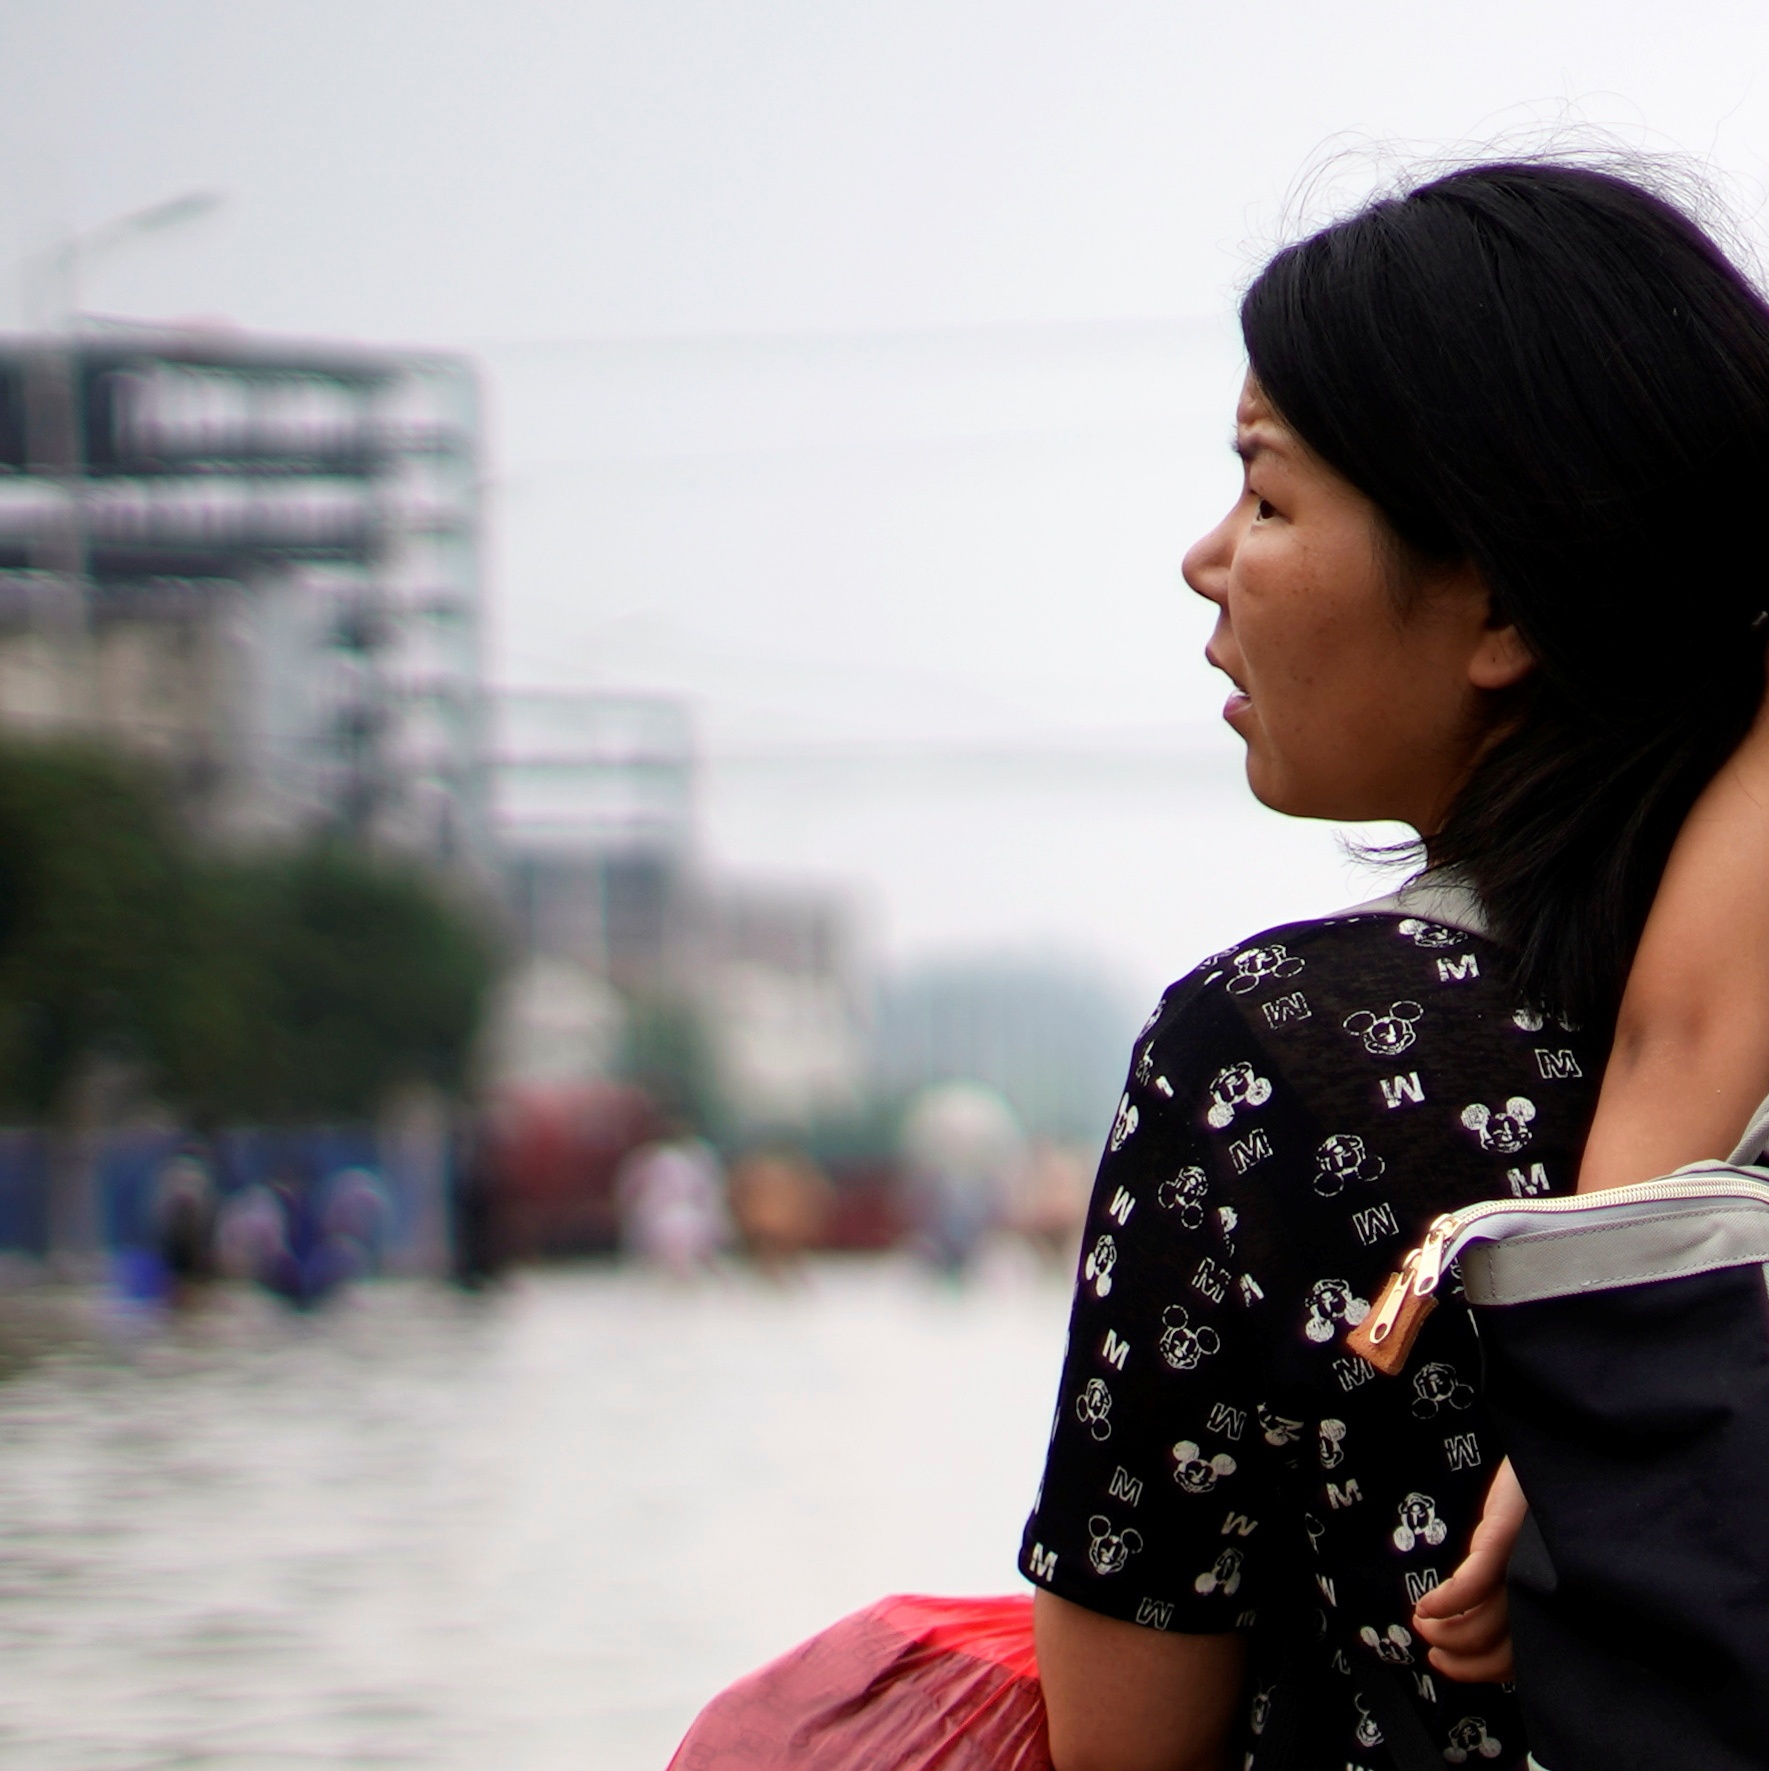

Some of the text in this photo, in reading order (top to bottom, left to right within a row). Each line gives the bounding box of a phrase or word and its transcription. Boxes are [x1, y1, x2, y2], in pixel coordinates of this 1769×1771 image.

[1437, 954, 1480, 983] M
[1536, 1048, 1583, 1080] M
[1228, 1128, 1274, 1175] M
[1508, 1162, 1550, 1197] M
[1102, 1329, 1131, 1371] M
[1332, 1356, 1375, 1391] M
[1109, 1466, 1144, 1506] M
[1326, 1478, 1364, 1509] M
[1029, 1542, 1059, 1582] M
